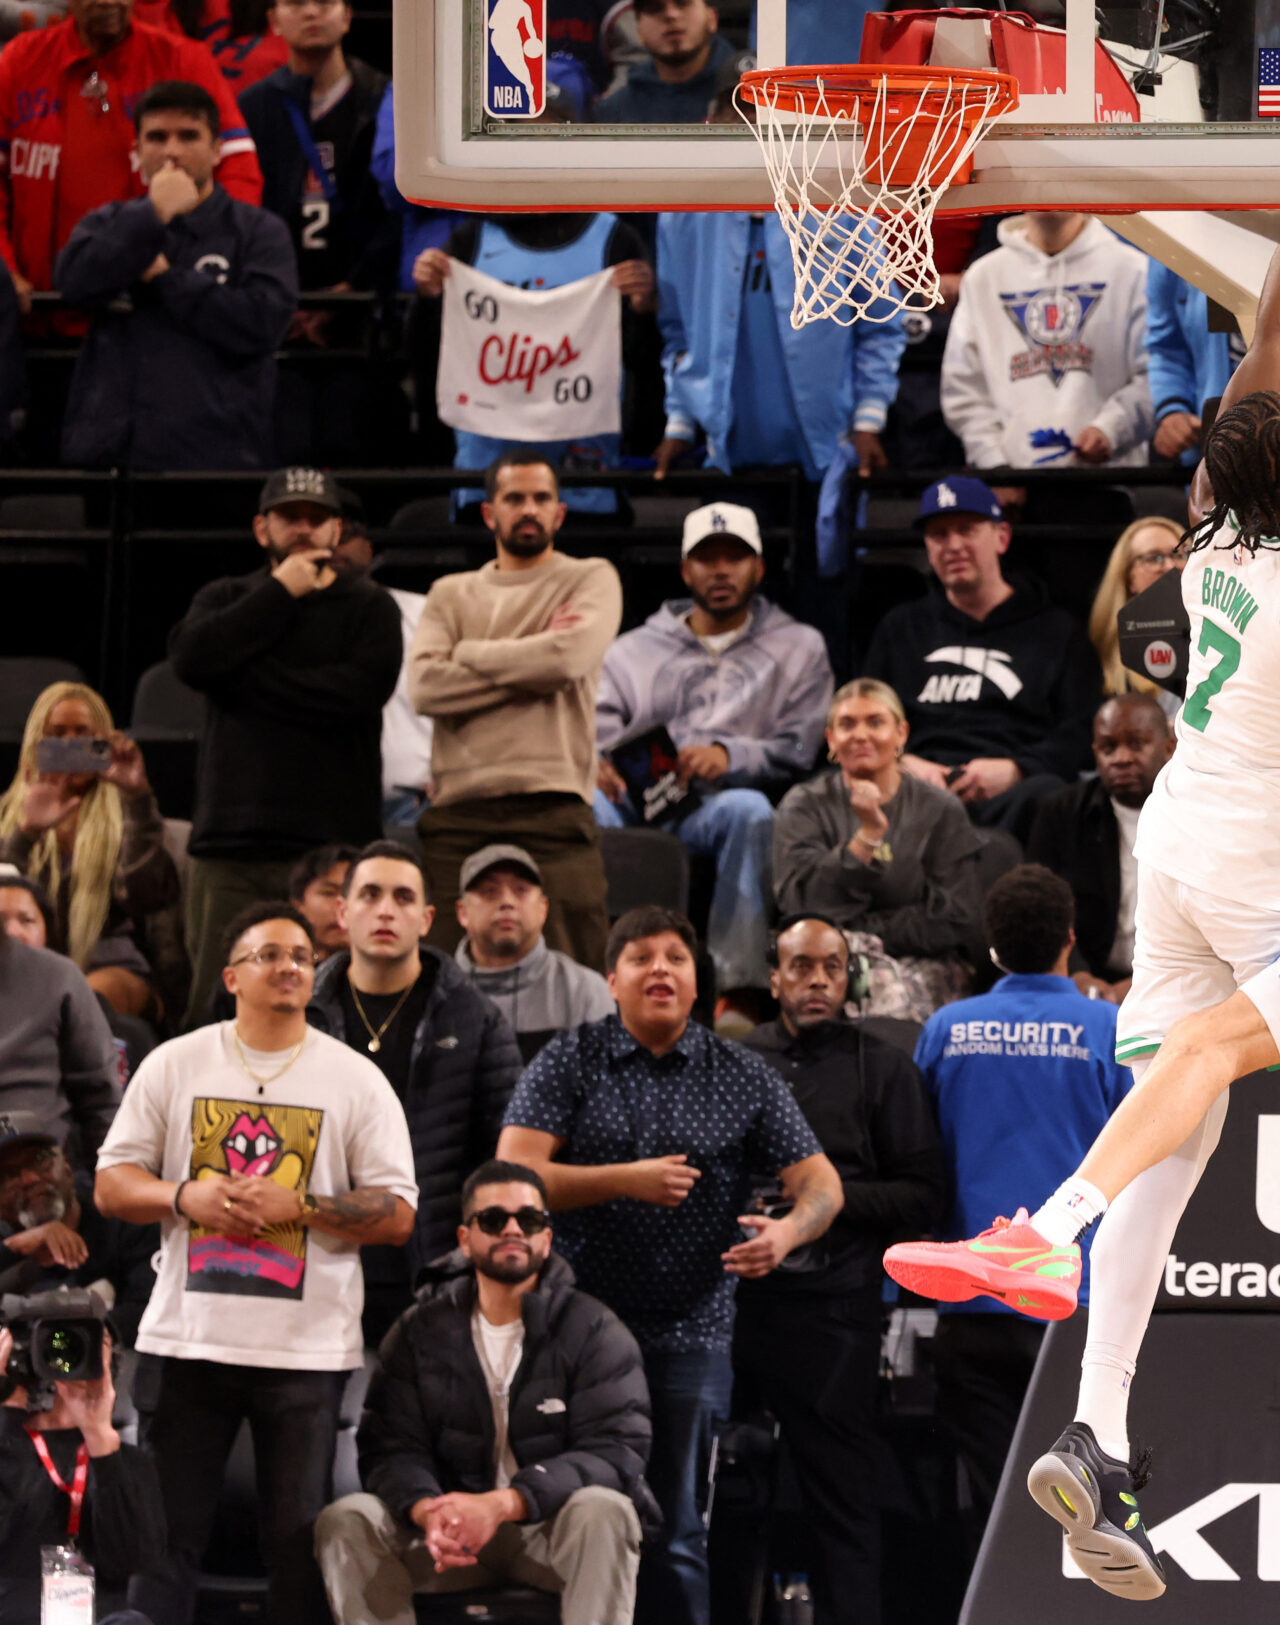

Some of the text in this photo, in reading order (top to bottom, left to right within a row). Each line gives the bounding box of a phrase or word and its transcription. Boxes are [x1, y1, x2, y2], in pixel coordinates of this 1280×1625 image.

[494, 86, 523, 108] NBA
[303, 203, 330, 248] 2
[465, 290, 498, 325] GO
[478, 332, 581, 394] Clips
[554, 375, 592, 404] GO
[1202, 567, 1260, 636] BROWN
[917, 674, 983, 704] ANTA
[1182, 616, 1242, 733] 7
[950, 1020, 1085, 1045] SECURITY
[1006, 1043, 1049, 1058] LIVES
[1051, 1044, 1091, 1062] HERE
